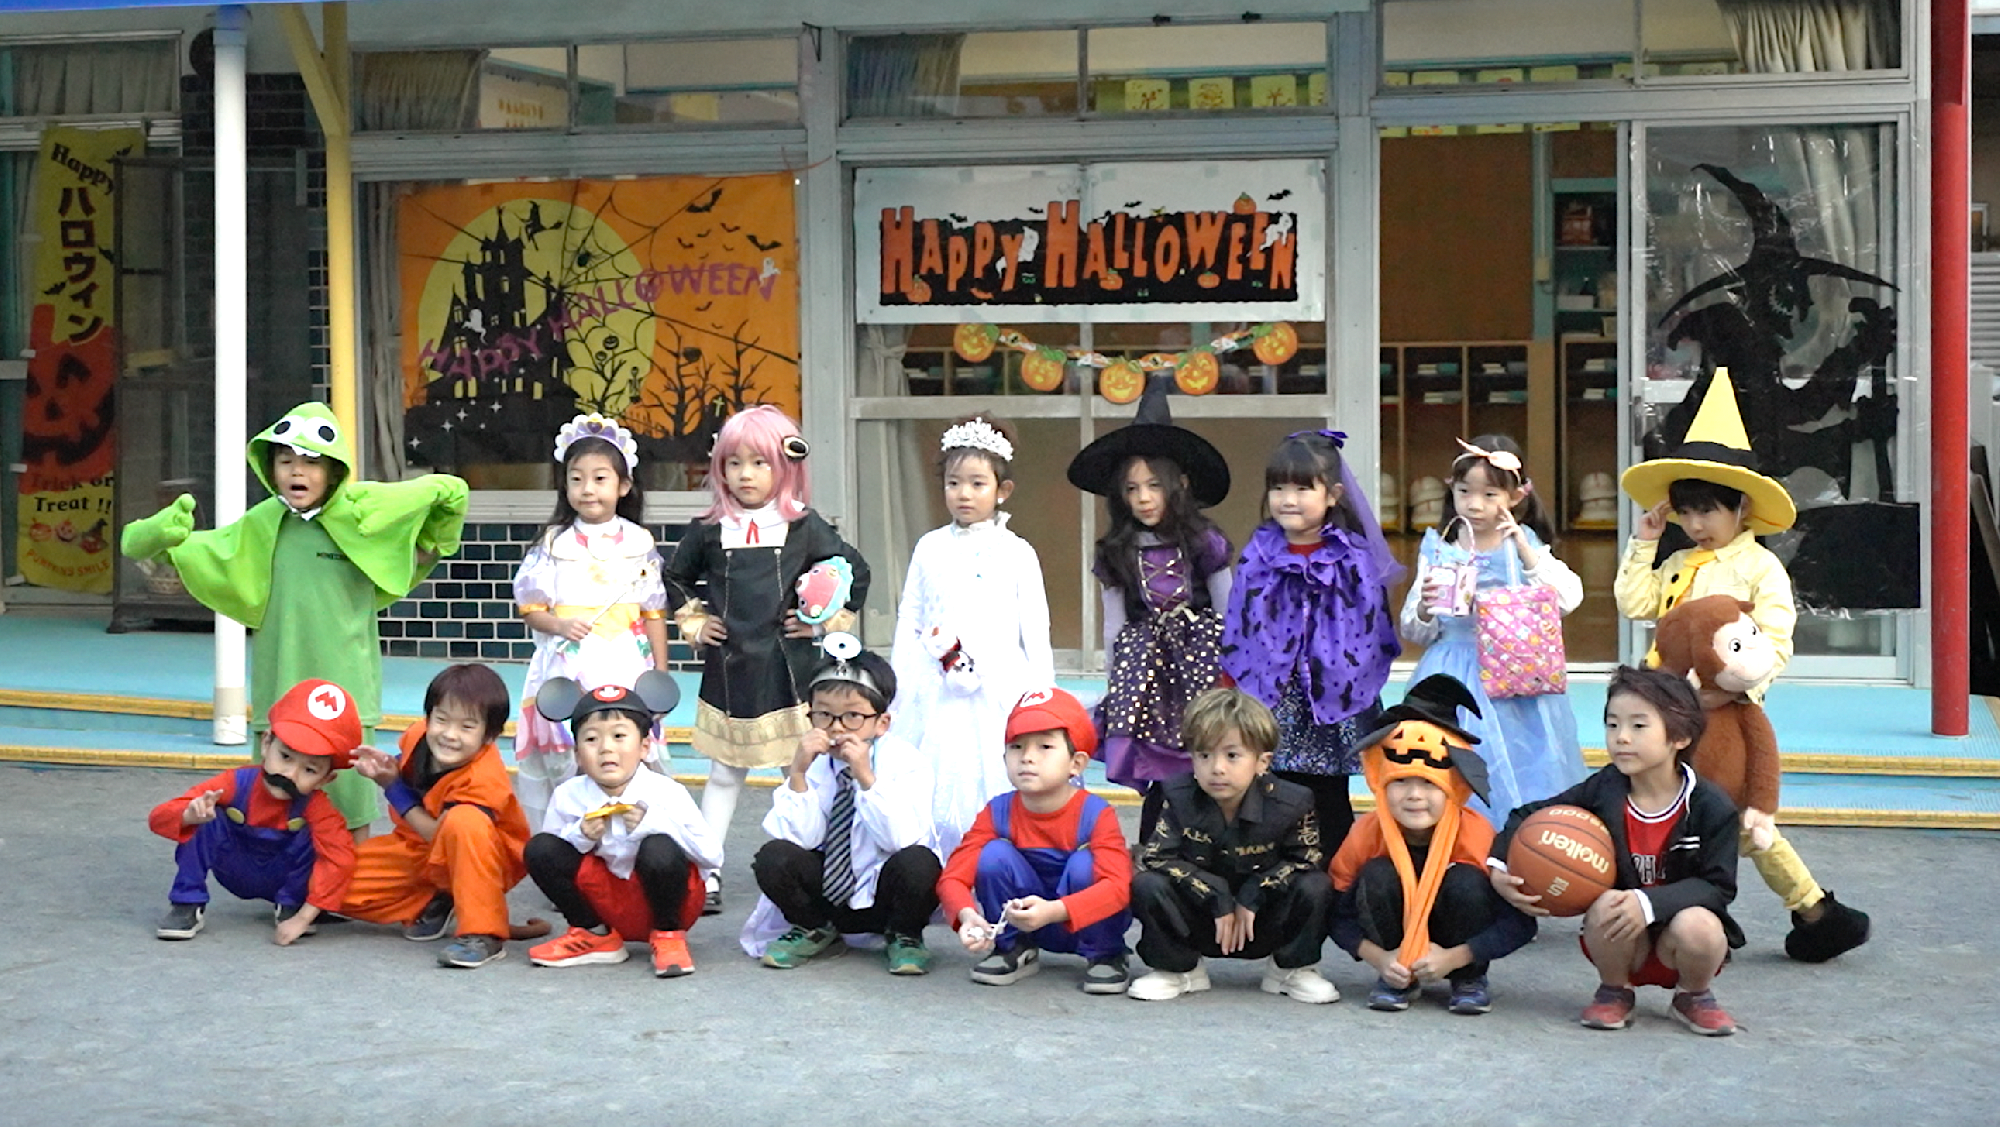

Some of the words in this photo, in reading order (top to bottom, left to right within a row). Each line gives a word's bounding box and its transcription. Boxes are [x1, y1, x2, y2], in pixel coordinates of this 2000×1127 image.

[51, 143, 114, 196] Happy
[58, 187, 104, 344] ハロウィン
[1042, 199, 1295, 291] HALLOWEEN
[418, 328, 542, 381] HAPPY
[548, 263, 778, 343] HALLOWEEN
[34, 497, 89, 512] Treat
[90, 476, 114, 488] or
[1541, 830, 1609, 874] molten
